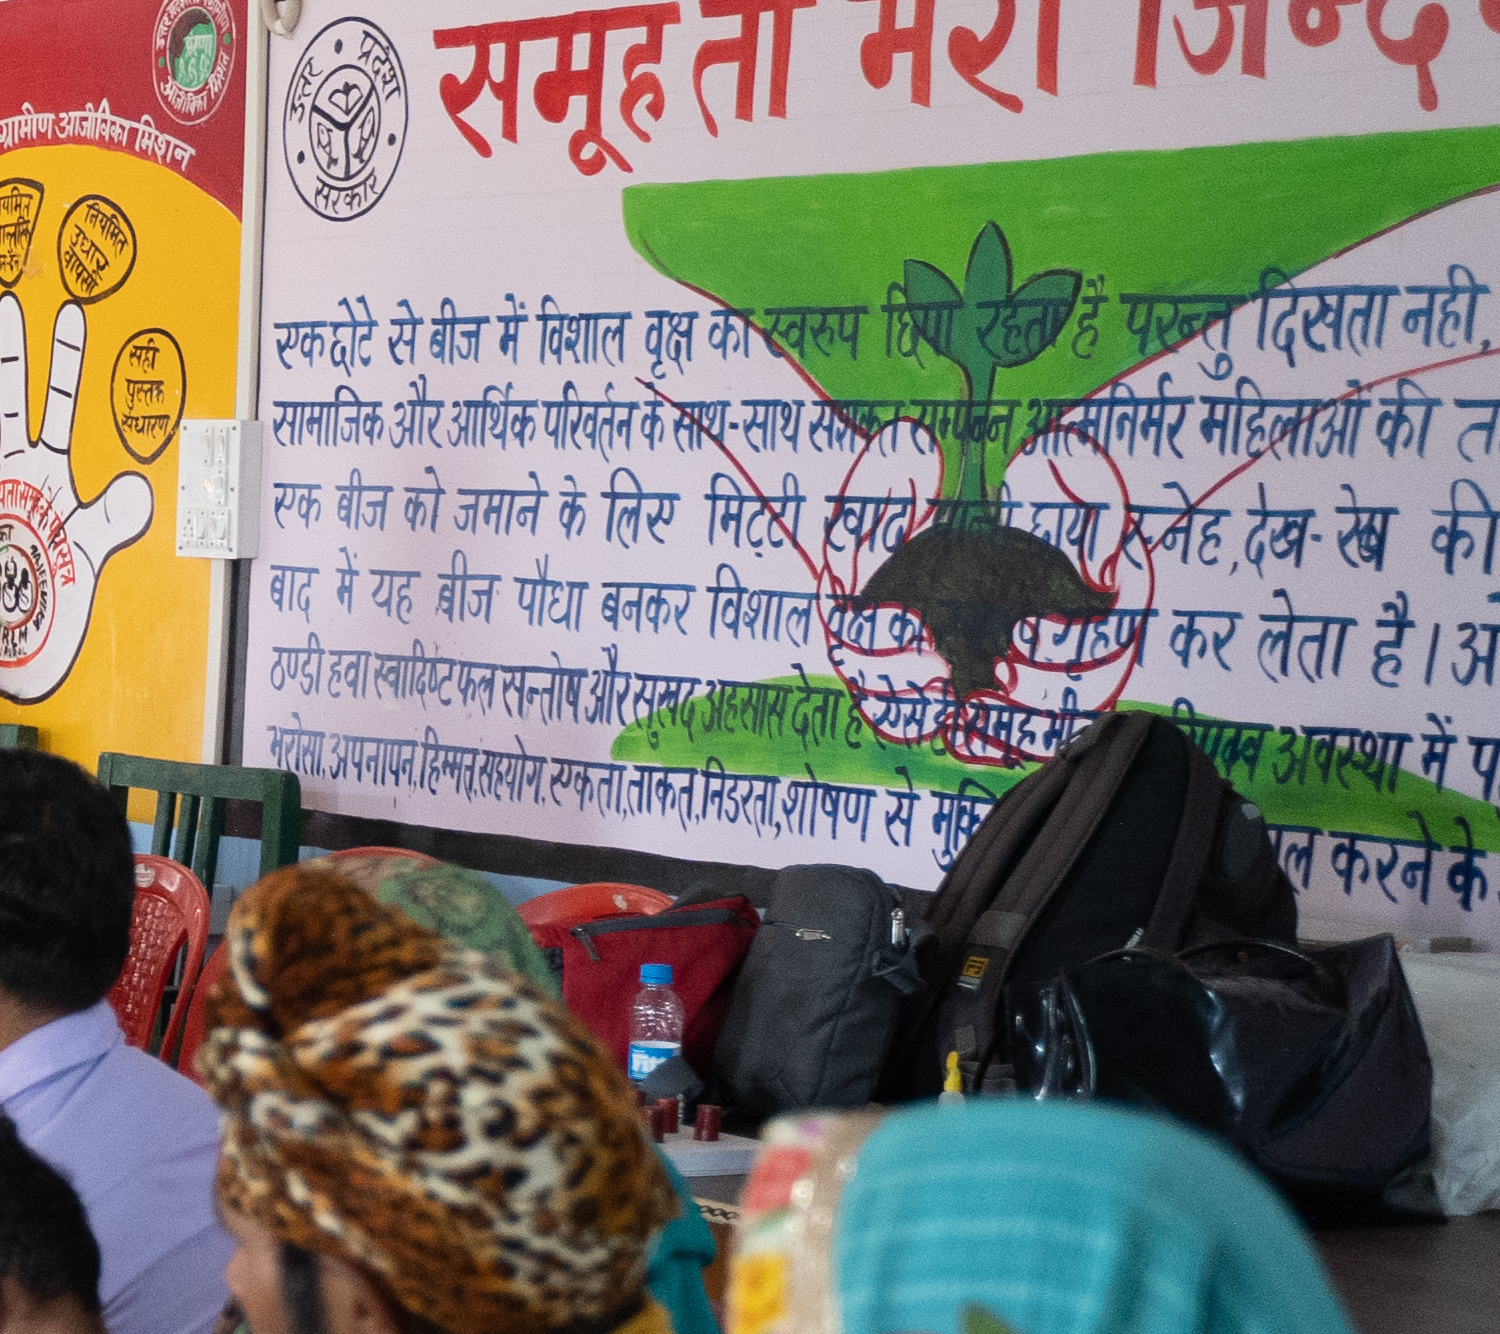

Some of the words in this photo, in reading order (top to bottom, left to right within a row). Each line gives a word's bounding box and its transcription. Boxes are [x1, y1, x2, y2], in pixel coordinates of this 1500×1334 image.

[433, 1, 681, 176] समूह
[314, 167, 379, 215] सरकार
[388, 298, 423, 367] से
[429, 297, 490, 365] बीज
[497, 293, 529, 366] में
[536, 294, 632, 367] विशाल
[644, 309, 699, 380] वृक्ष
[708, 307, 754, 362] का
[976, 296, 1072, 364] रहता
[1071, 274, 1109, 360] है
[1119, 291, 1251, 381] परन्तु
[1250, 266, 1402, 368] दिखता
[272, 384, 383, 448] सामाजिक
[388, 373, 446, 449] और
[447, 382, 539, 451] आर्थिक
[541, 380, 641, 463] परिवर्तन
[640, 381, 665, 451] के
[1375, 377, 1443, 460] की
[335, 468, 393, 532] बीज
[404, 466, 446, 533] को
[454, 471, 549, 538] जमाने
[558, 475, 587, 540] के
[1431, 478, 1500, 576] की
[270, 563, 320, 623] बाद
[336, 546, 360, 615] में
[368, 567, 421, 626] यह
[436, 549, 501, 624] बीज
[513, 553, 590, 633] पौधा
[601, 581, 697, 636] बनकर
[706, 562, 821, 647] विशाल
[1169, 608, 1244, 672] कर
[1257, 587, 1359, 684] लेता
[270, 631, 326, 696] ठण्डी
[327, 650, 372, 699] हवा
[457, 660, 499, 716] फल
[499, 650, 589, 725] सन्तोष
[584, 643, 632, 727] और
[632, 671, 703, 750] सुखद
[701, 678, 794, 739] अहसास
[790, 663, 847, 751] देता
[844, 668, 869, 749] है
[1273, 723, 1413, 795] अवस्था
[1421, 713, 1458, 794] में
[782, 762, 879, 843] शोषण
[884, 765, 921, 847] से
[1329, 810, 1443, 906] करने
[1446, 815, 1488, 912] के
